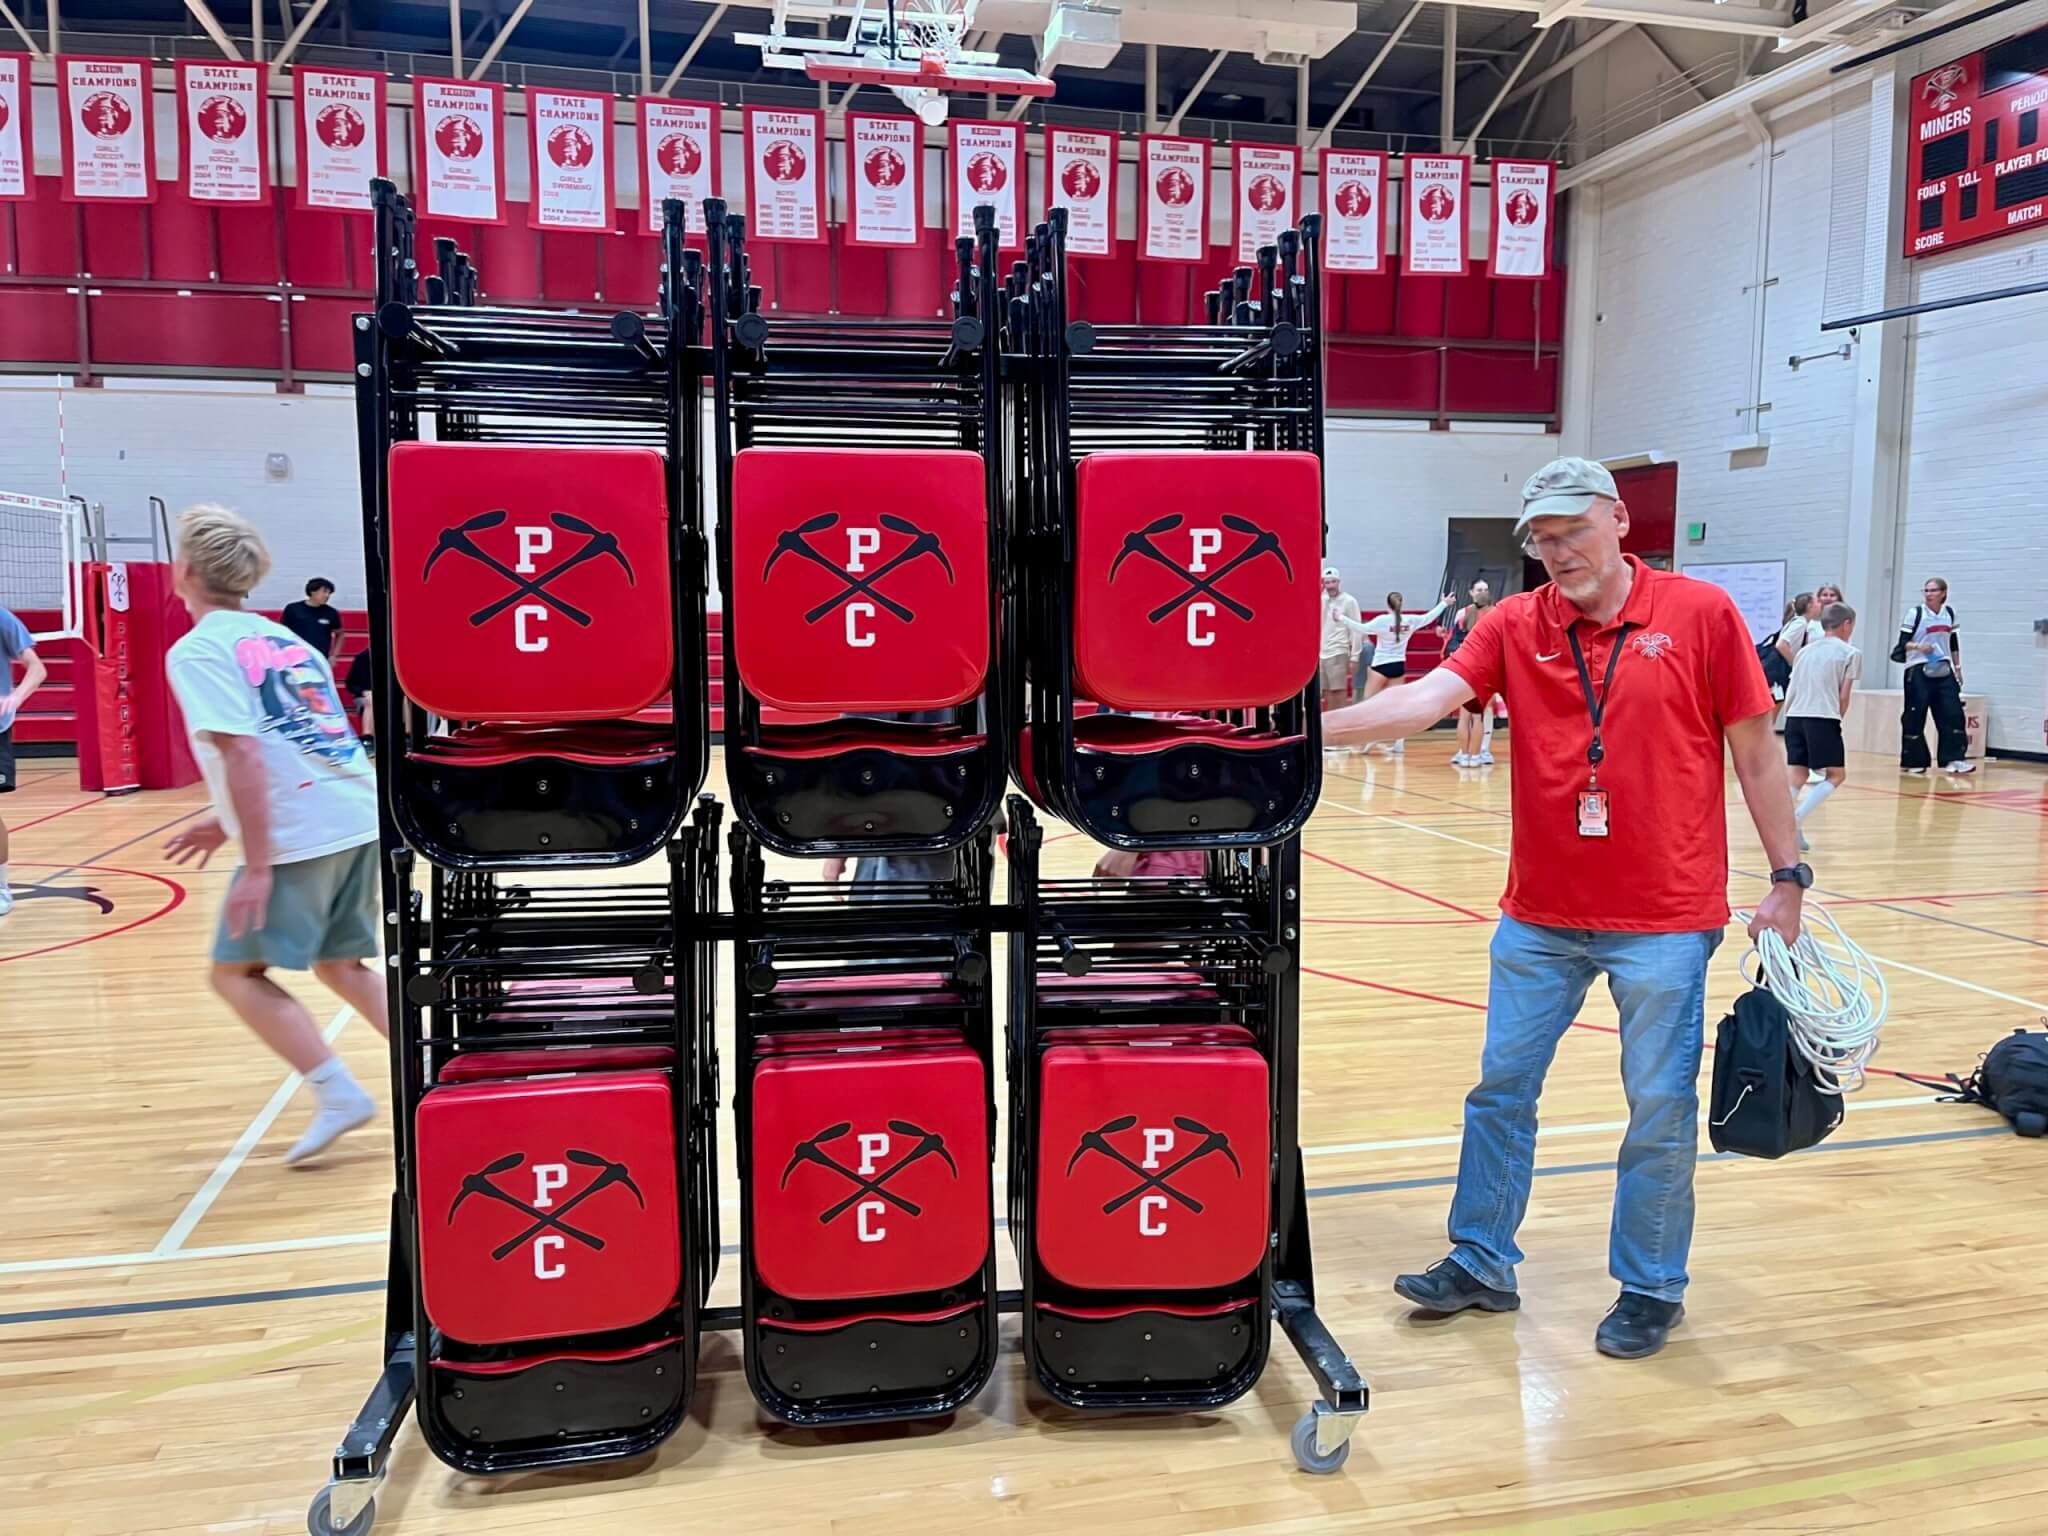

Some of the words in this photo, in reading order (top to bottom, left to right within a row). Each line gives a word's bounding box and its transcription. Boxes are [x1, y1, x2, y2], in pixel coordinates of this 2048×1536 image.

[203, 68, 239, 78] STATE
[72, 77, 137, 87] CHAMPIONS
[190, 80, 253, 91] CHAMPIONS
[321, 76, 356, 87] STATE
[308, 87, 371, 101] CHAMPIONS
[427, 99, 489, 112] CHAMPIONS
[552, 97, 586, 108] STATE
[2010, 88, 2048, 113] PERIOD
[539, 109, 600, 121] CHAMPIONS
[768, 114, 800, 124] STATE
[649, 118, 707, 130] CHAMPIONS
[869, 121, 899, 131] STATE
[1920, 106, 1972, 140] MINERS
[756, 126, 812, 137] CHAMPIONS
[857, 132, 911, 143] CHAMPIONS
[960, 138, 1012, 148] CHAMPIONS
[1067, 134, 1096, 145] STATE
[1056, 145, 1106, 157] CHAMPIONS
[1150, 153, 1200, 164] CHAMPIONS
[1340, 156, 1366, 165] STATE
[1995, 152, 2033, 176] PLAYER
[1243, 160, 1291, 172] CHAMPIONS
[1330, 167, 1377, 177] CHAMPIONS
[1414, 171, 1459, 180] CHAMPIONS
[1500, 176, 1545, 185] CHAMPIONS
[1917, 181, 1947, 201] FOULS
[2007, 203, 2042, 225] MATCH
[1914, 231, 1945, 251] SCORE
[514, 526, 553, 574] P
[846, 527, 881, 572] P
[1188, 528, 1222, 573] P
[514, 604, 549, 653] C
[845, 602, 876, 647] C
[1186, 602, 1216, 647] C
[857, 1132, 890, 1175] P
[1141, 1128, 1175, 1169] P
[531, 1162, 569, 1208] P
[857, 1200, 886, 1243] C
[1139, 1195, 1168, 1237] C
[533, 1235, 566, 1280] C
